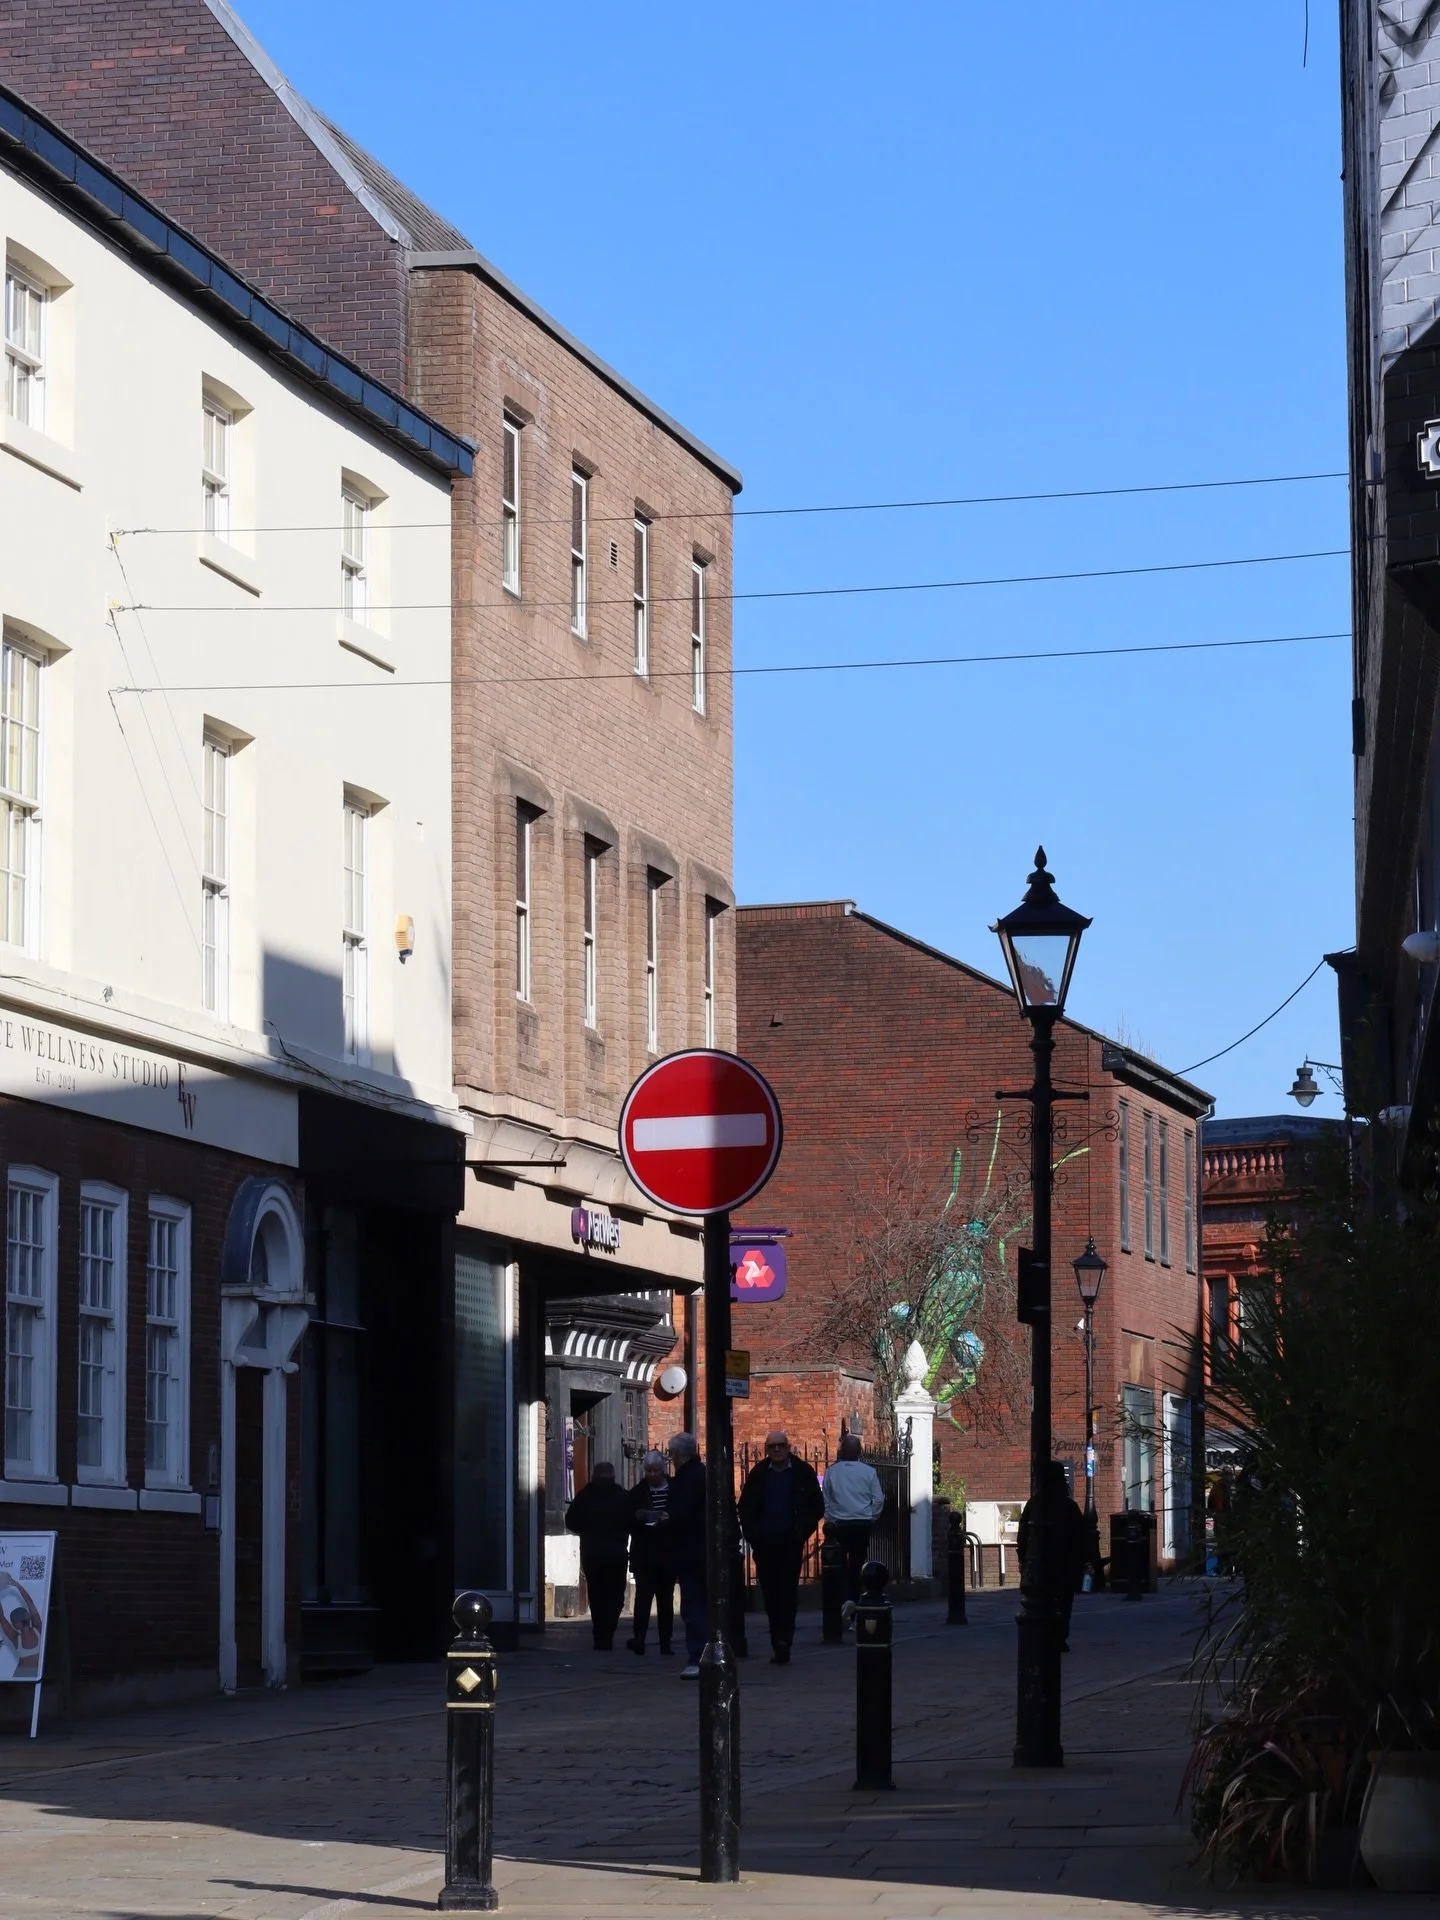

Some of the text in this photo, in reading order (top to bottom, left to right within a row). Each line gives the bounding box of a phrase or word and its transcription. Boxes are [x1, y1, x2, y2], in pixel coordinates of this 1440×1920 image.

[21, 1025, 104, 1074] WELLNESS
[112, 1052, 169, 1090] STUDIO
[58, 1074, 76, 1092] 2024
[588, 1210, 621, 1249] NatWest
